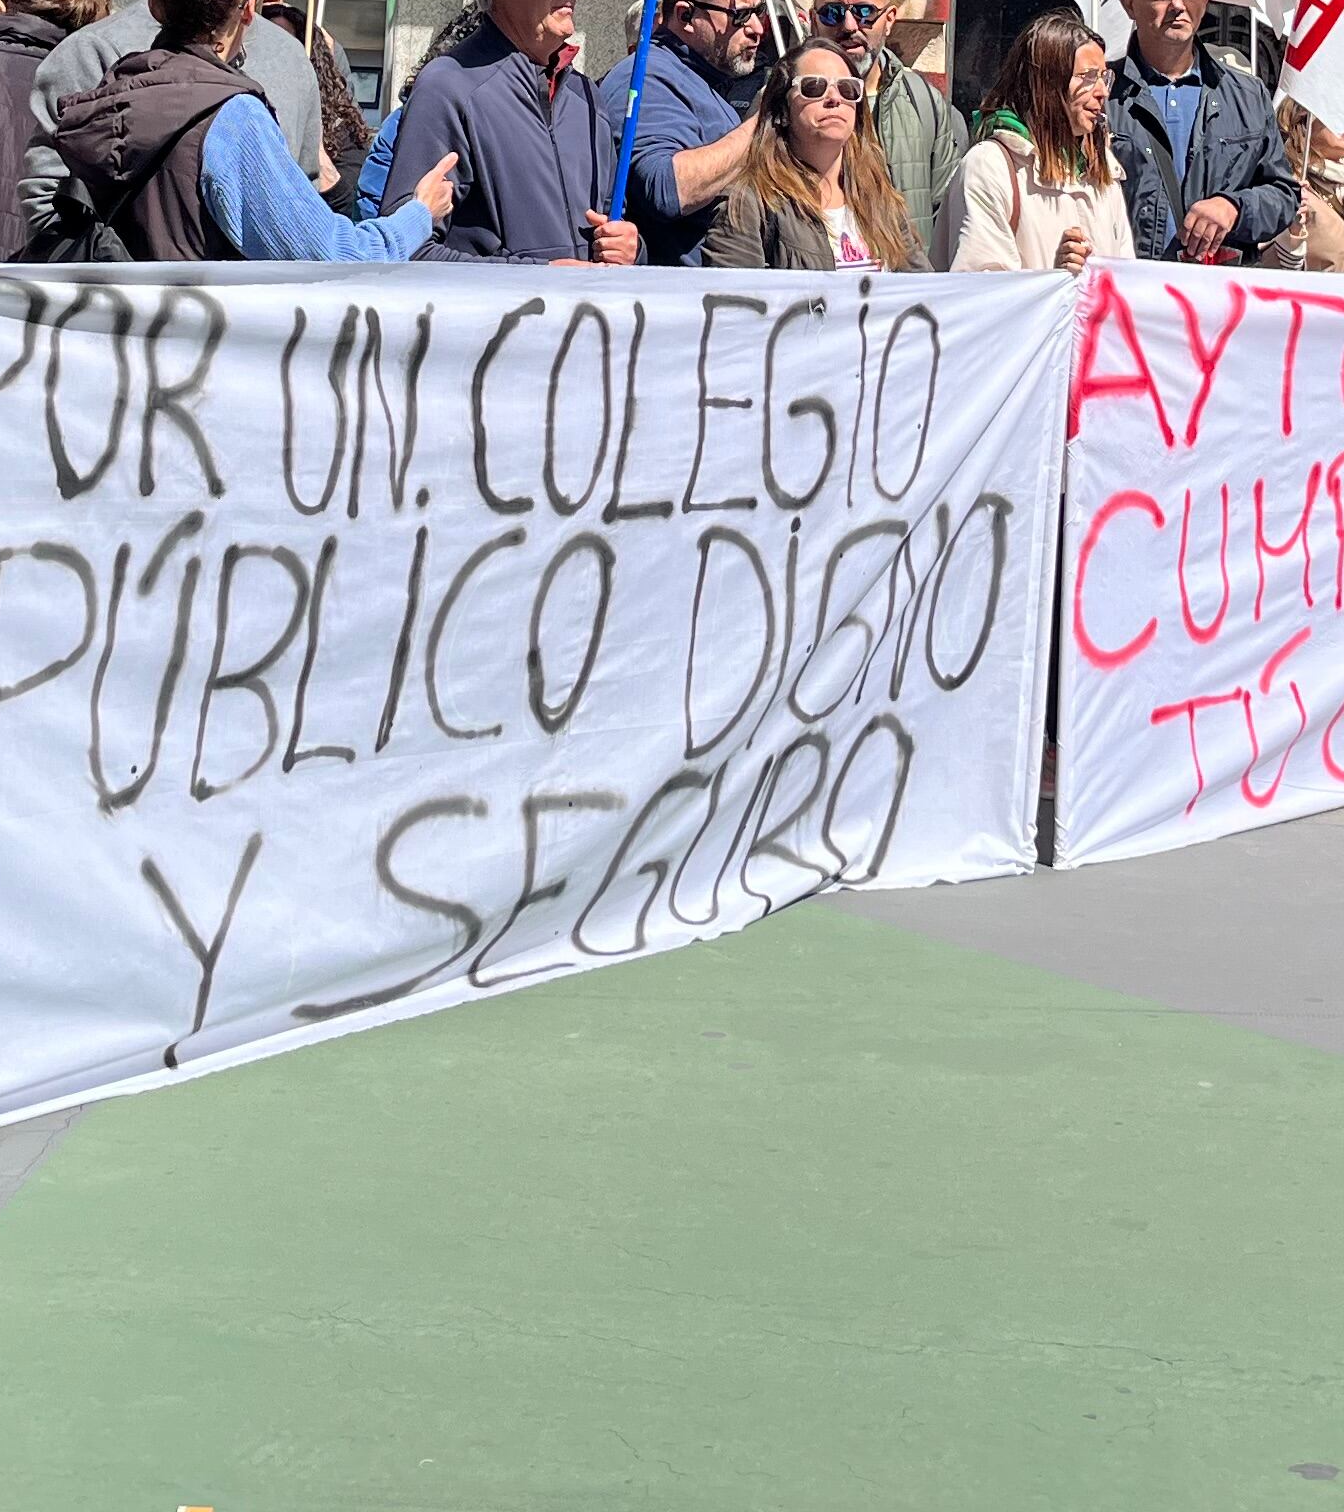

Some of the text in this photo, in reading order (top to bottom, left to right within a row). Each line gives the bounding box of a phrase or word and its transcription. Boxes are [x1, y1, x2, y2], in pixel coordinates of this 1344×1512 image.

[1150, 625, 1313, 817] TÚ
[140, 714, 915, 1070] Y SEGURO
